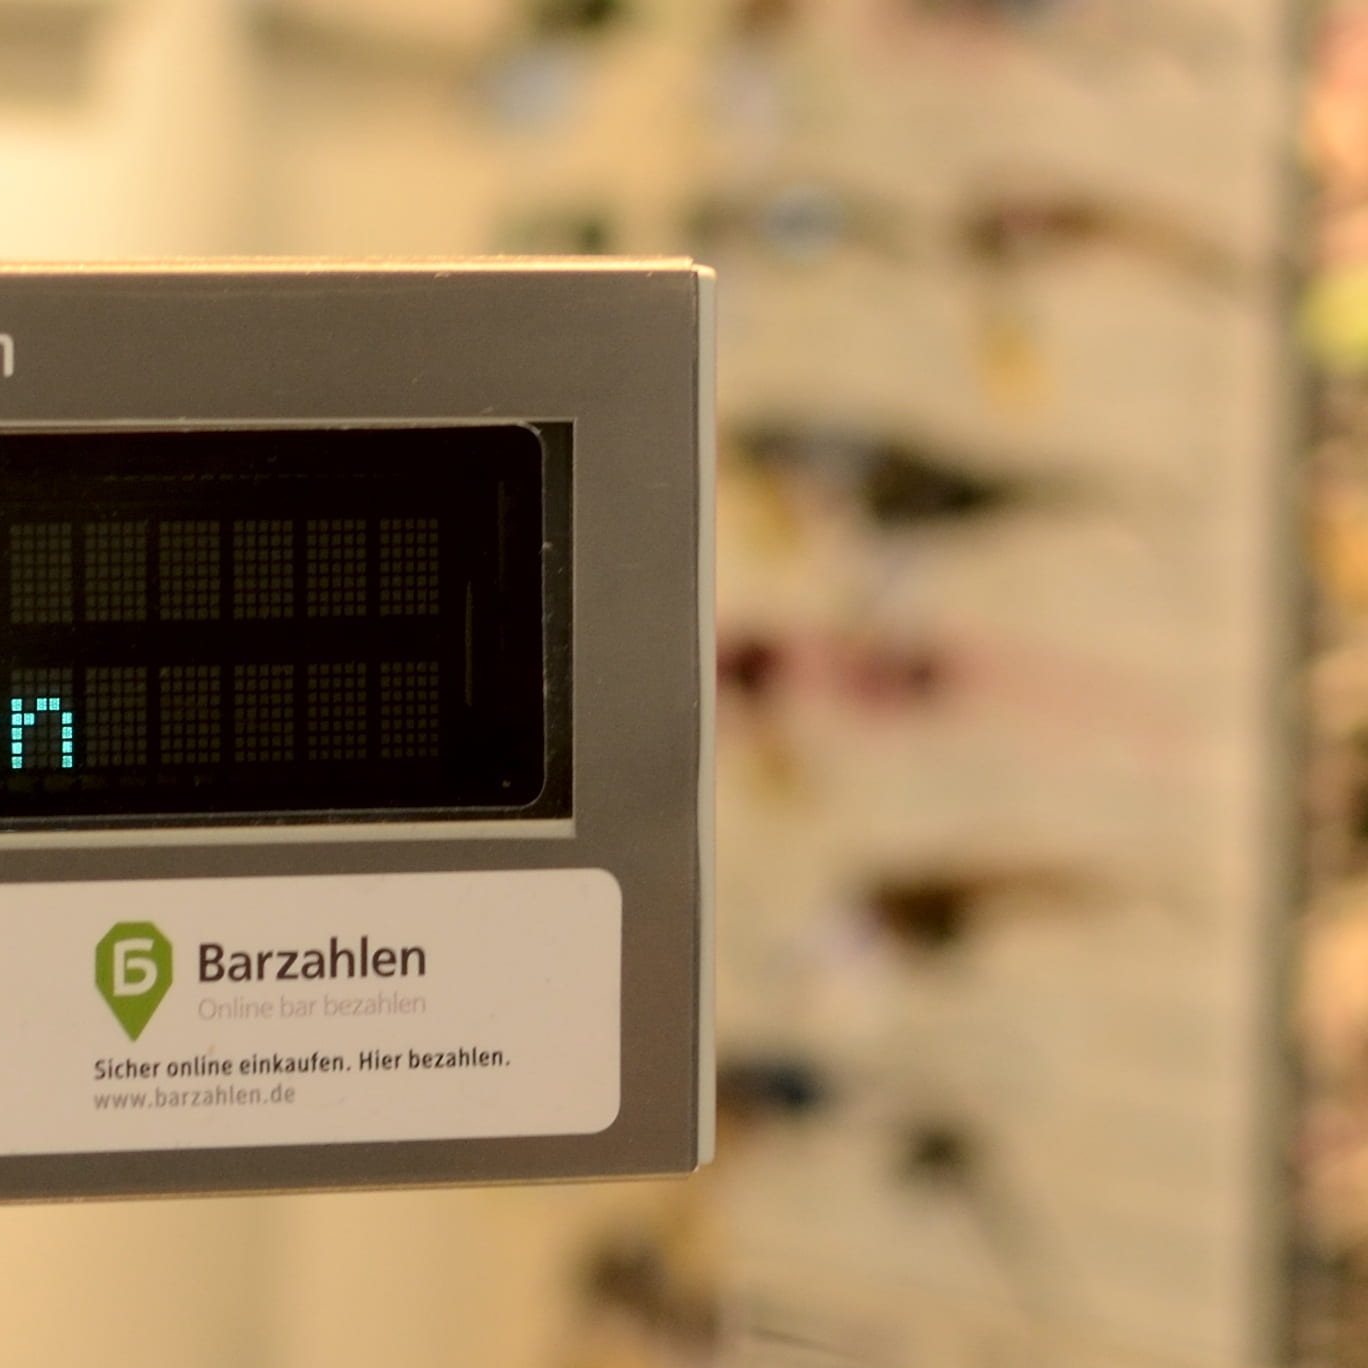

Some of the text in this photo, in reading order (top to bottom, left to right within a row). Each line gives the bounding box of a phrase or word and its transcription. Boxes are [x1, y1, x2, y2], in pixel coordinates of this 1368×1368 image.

[198, 936, 428, 983] Barzahlen
[197, 990, 427, 1021] Online bar bezahlen
[94, 1046, 512, 1081] Sicher online einkaufen. Hier bezahlen.
[93, 1082, 296, 1110] www.barzahlen.de
